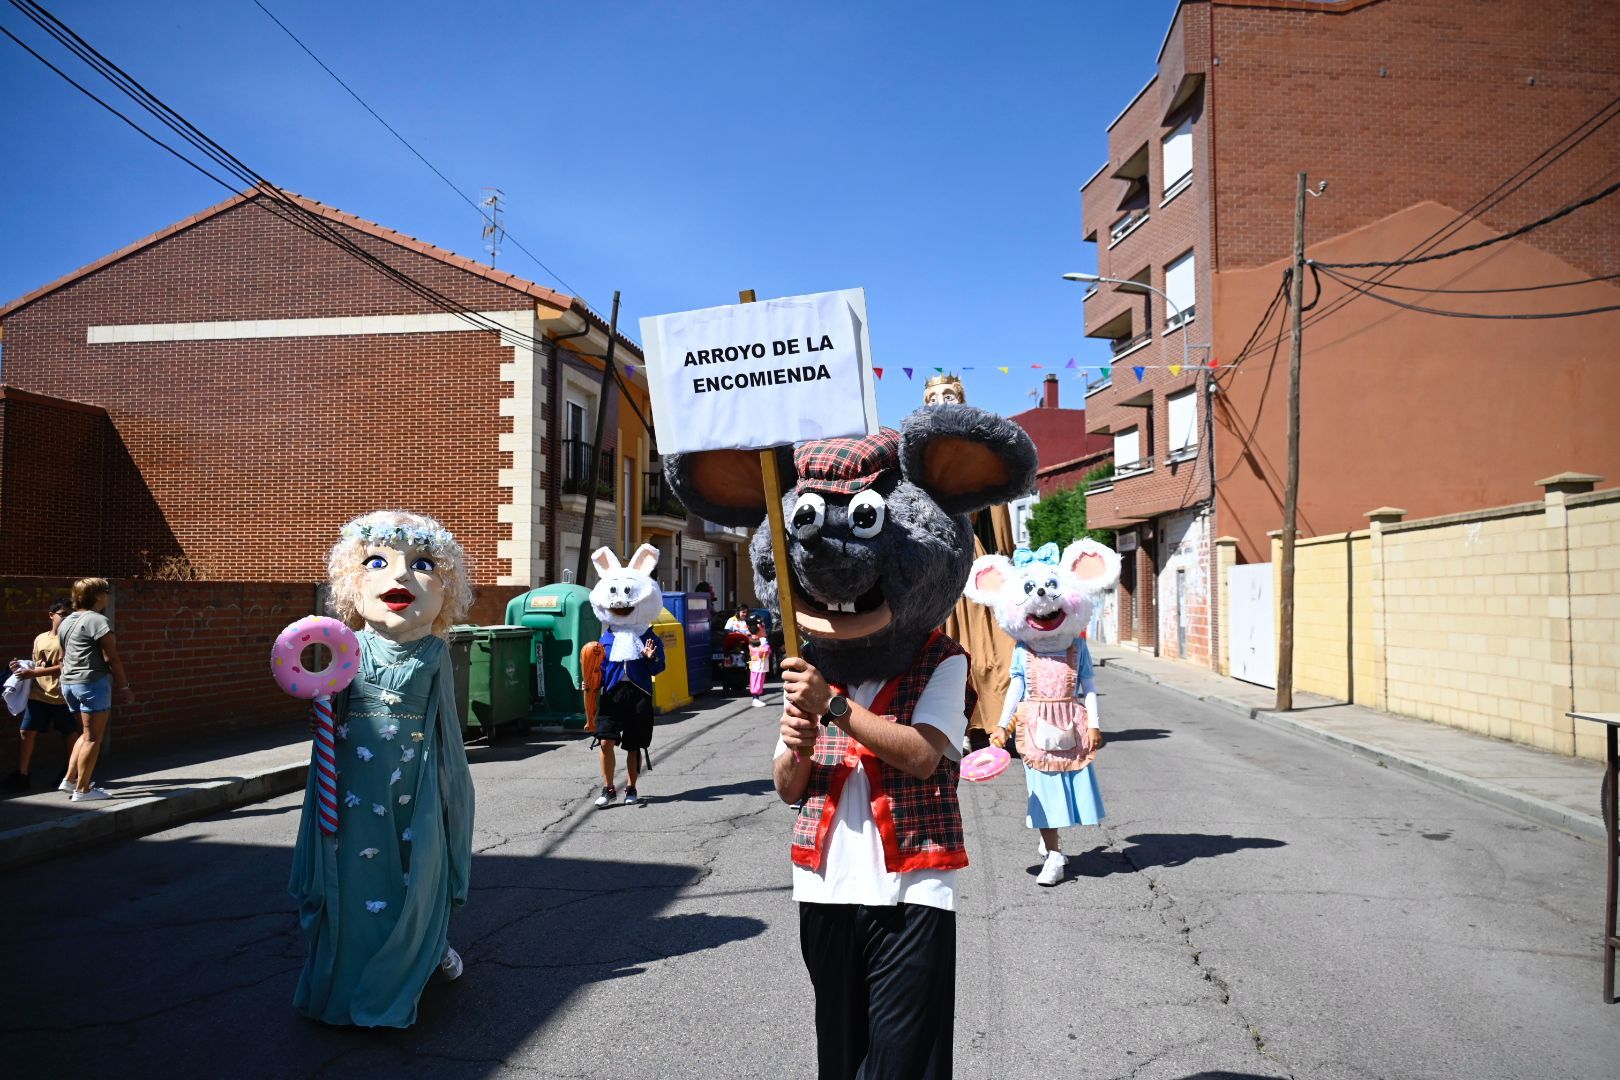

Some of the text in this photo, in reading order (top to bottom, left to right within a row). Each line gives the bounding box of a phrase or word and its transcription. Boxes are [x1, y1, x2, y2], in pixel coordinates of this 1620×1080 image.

[683, 334, 835, 367] ARROYO DE LA
[692, 364, 832, 394] ENCOMIENDA
